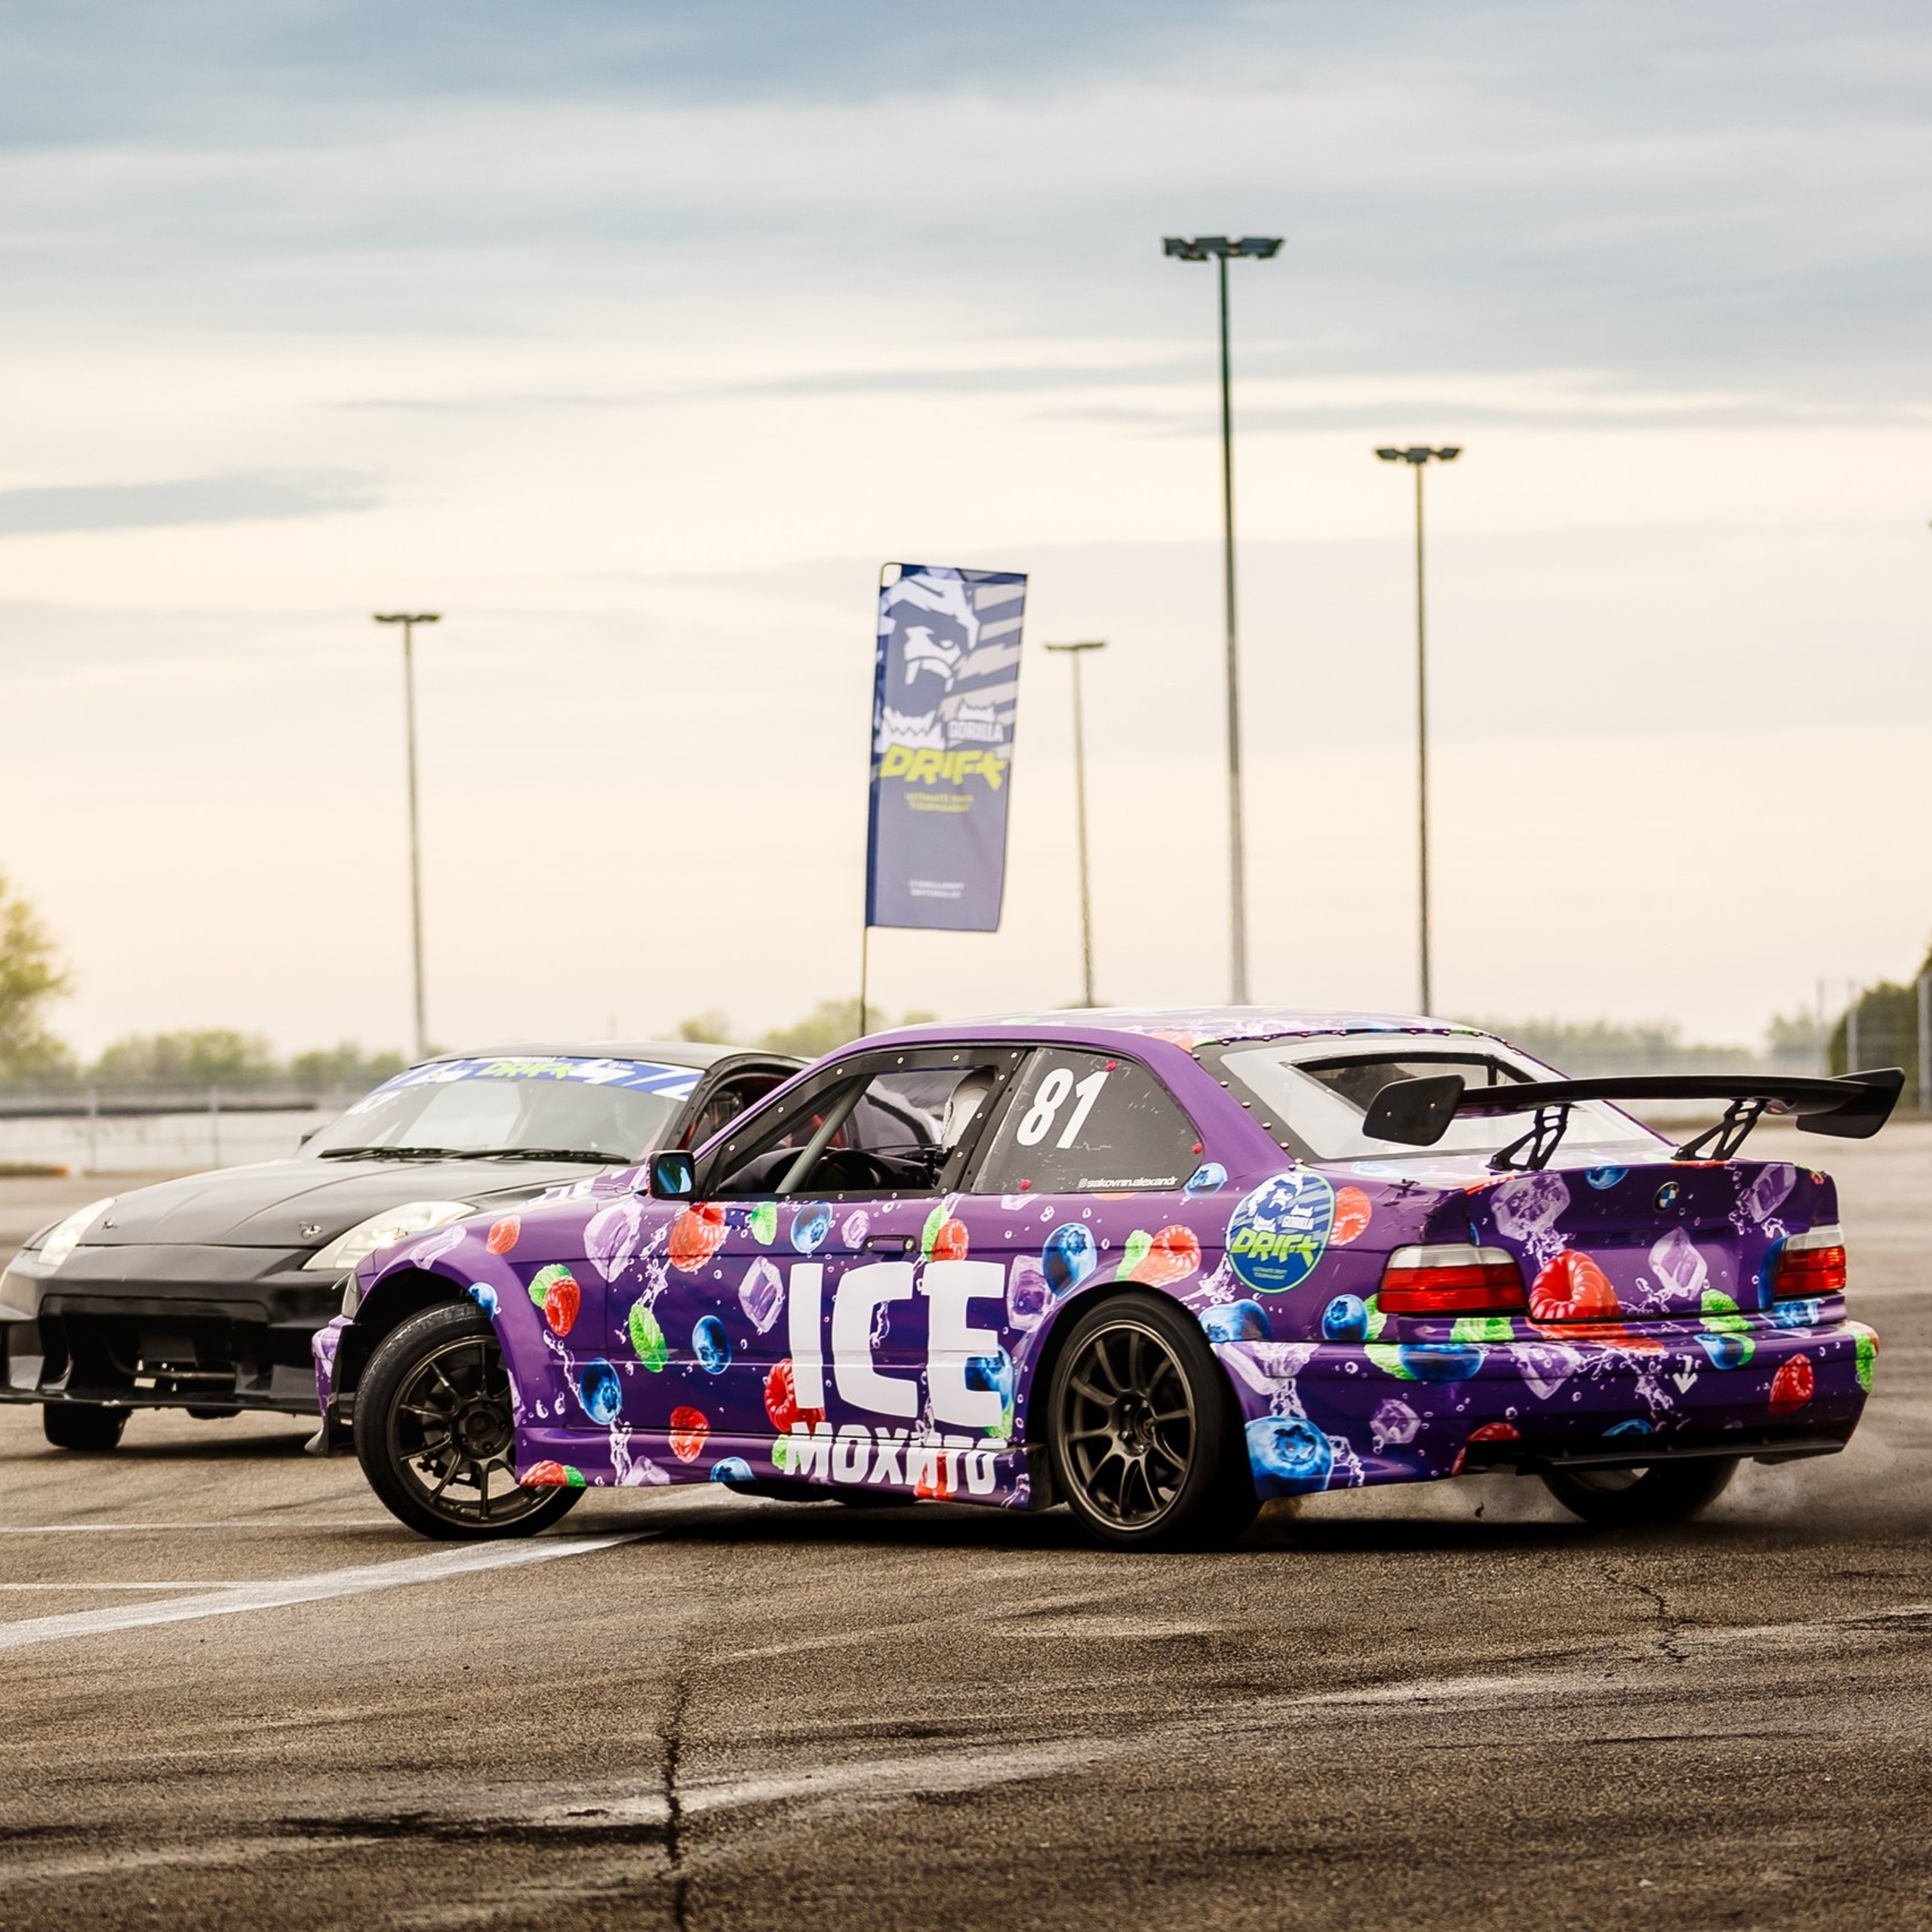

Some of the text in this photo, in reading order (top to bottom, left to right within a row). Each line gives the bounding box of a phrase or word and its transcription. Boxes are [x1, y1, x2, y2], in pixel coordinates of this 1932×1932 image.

[879, 743, 1008, 790] DRIFT
[475, 1061, 579, 1080] DRIFT
[1017, 1068, 1109, 1149] 81
[1229, 1226, 1319, 1268] DRIFT
[788, 1260, 1006, 1427] ICE
